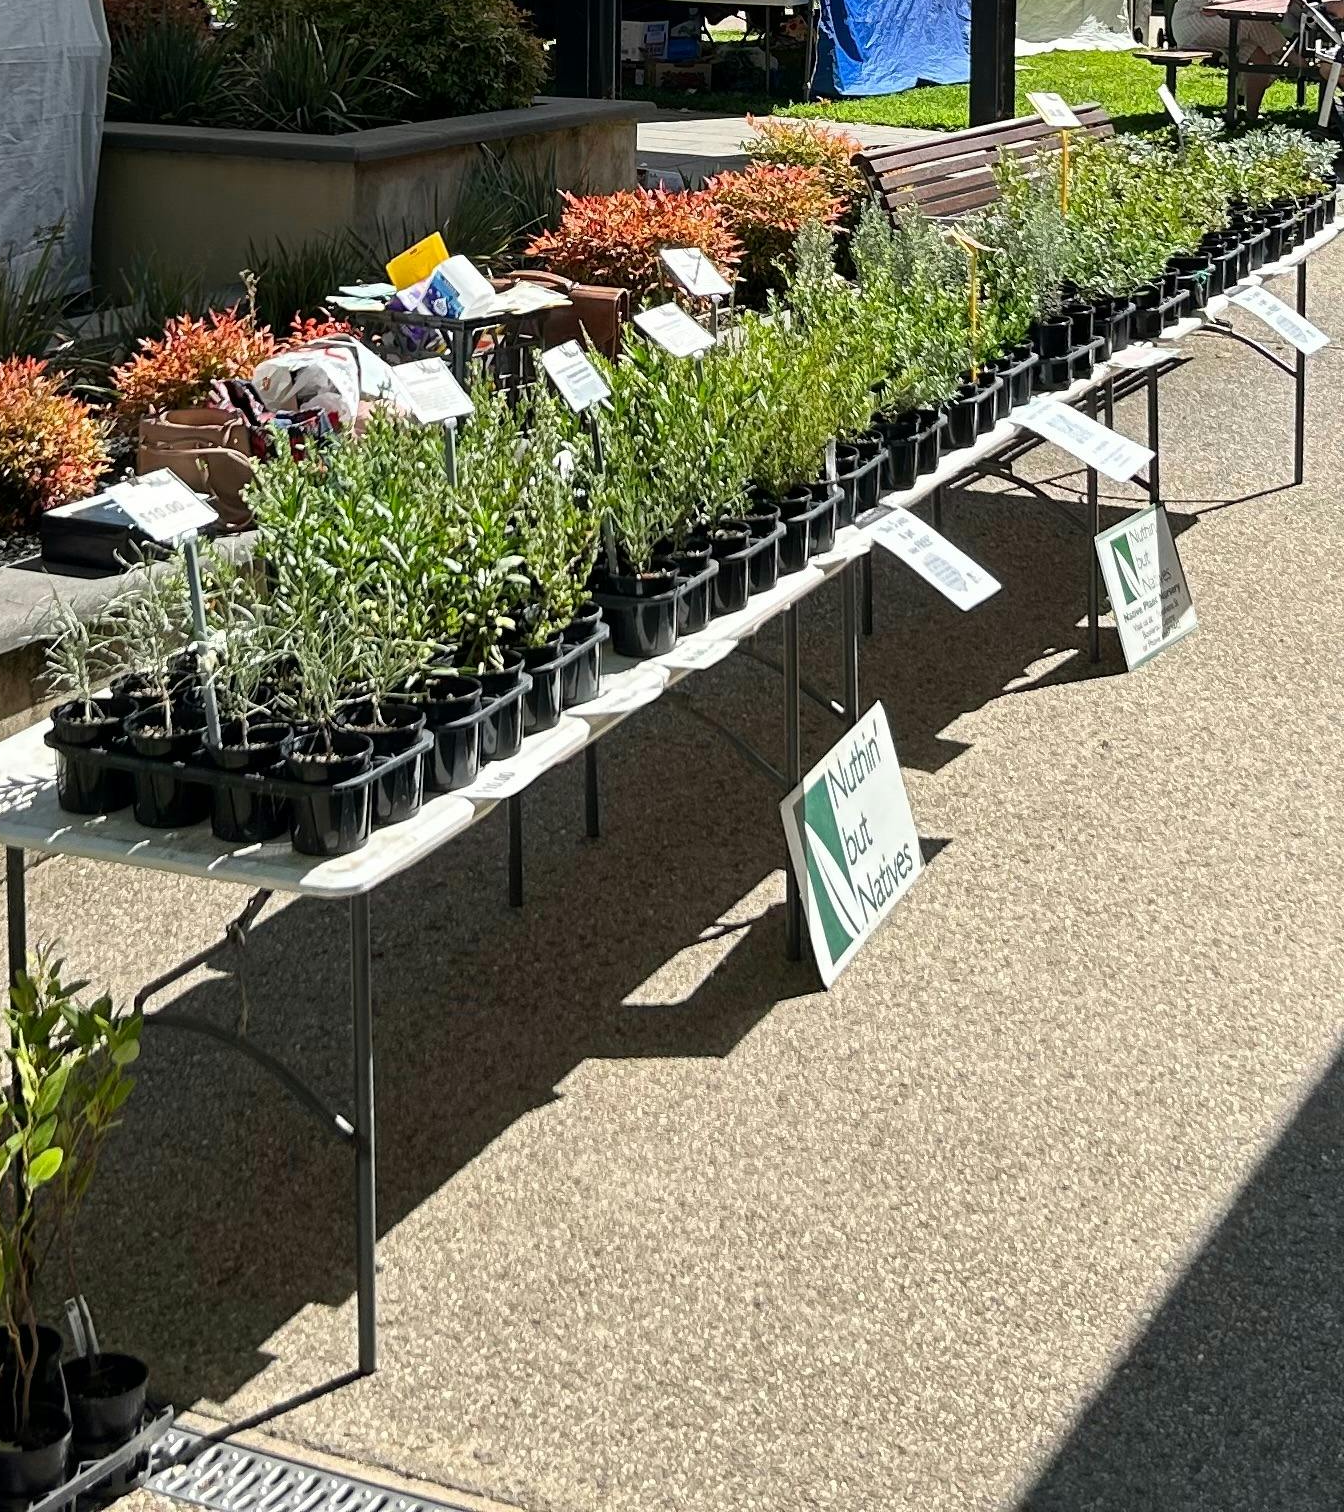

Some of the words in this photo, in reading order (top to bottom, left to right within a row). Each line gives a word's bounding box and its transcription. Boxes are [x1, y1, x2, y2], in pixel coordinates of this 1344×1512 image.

[1136, 550, 1150, 570] but
[827, 719, 881, 809] Nuthin'
[842, 811, 873, 865] but
[857, 843, 913, 924] Natives
